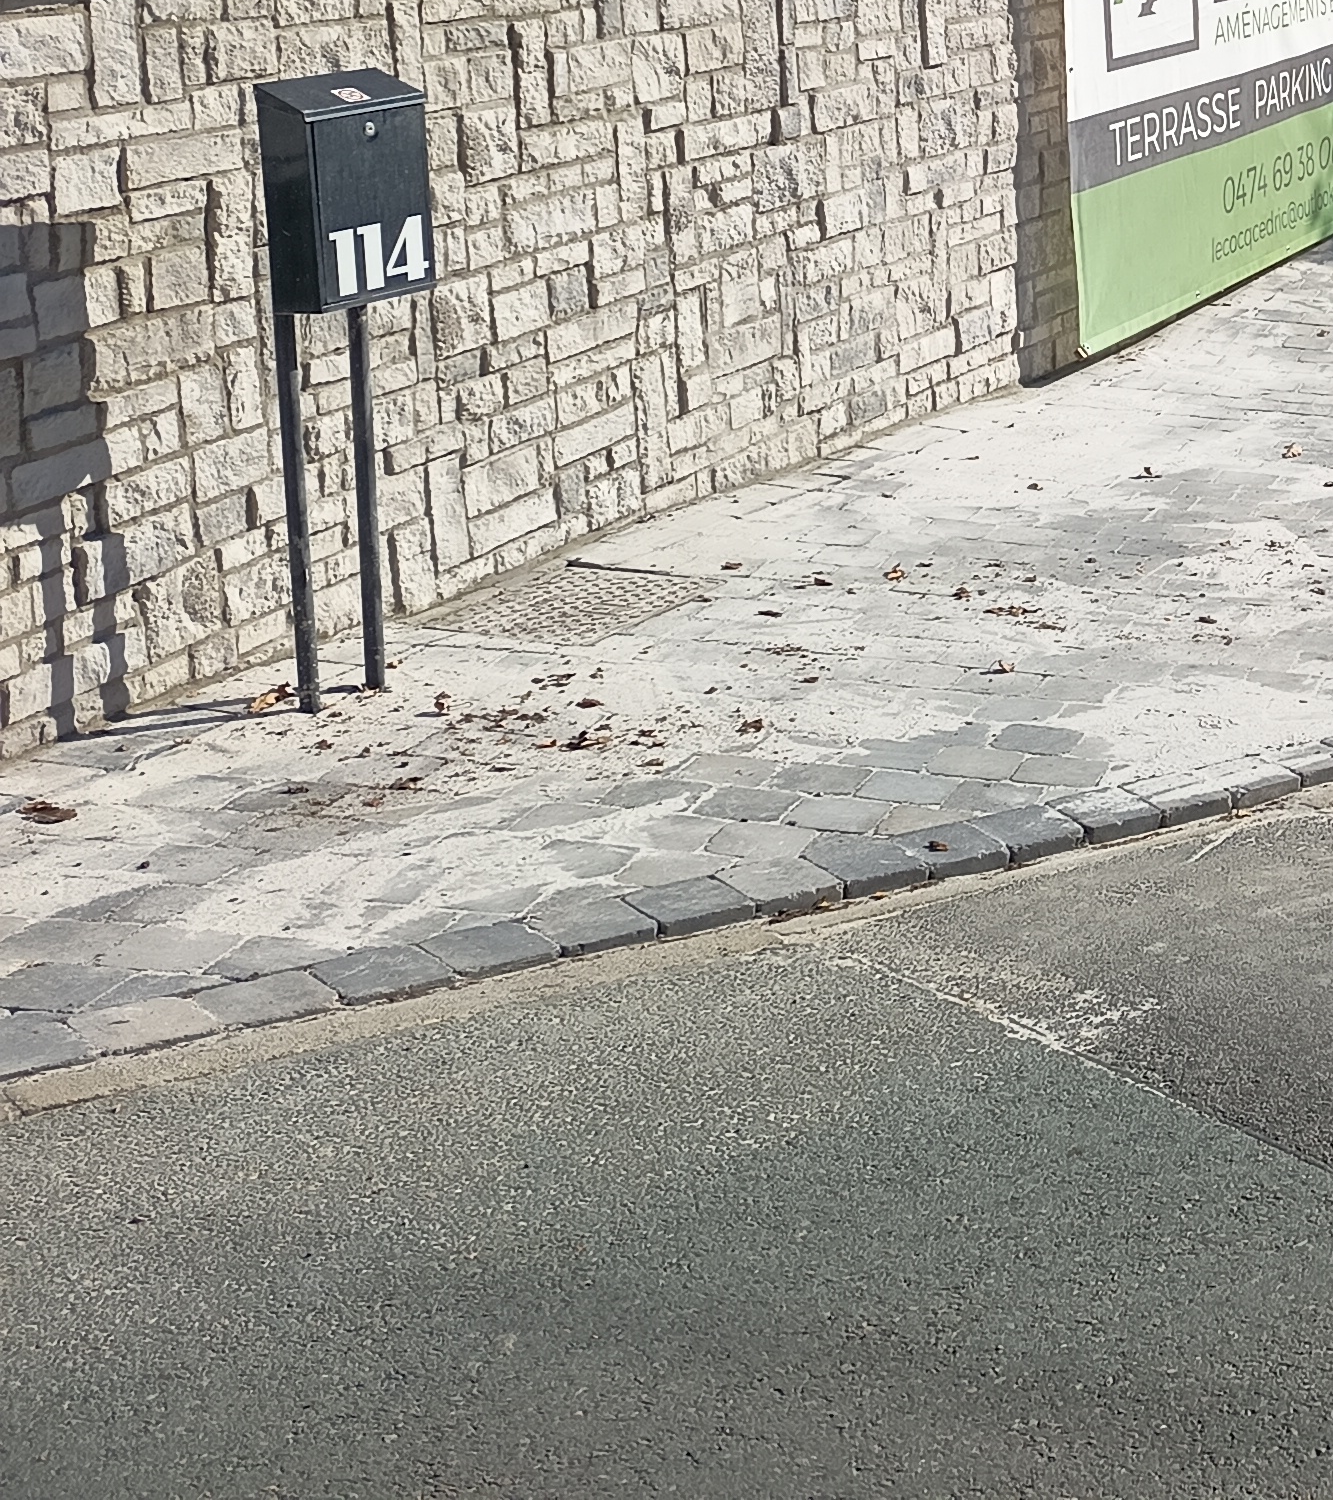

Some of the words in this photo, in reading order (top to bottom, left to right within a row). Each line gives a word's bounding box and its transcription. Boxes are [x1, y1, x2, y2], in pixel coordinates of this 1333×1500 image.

[1109, 87, 1241, 166] TERRASSE
[1255, 57, 1332, 120] PARKING
[1223, 162, 1268, 214] 0474
[1272, 151, 1293, 192] 69
[1297, 142, 1315, 181] 38
[328, 214, 430, 297] 114
